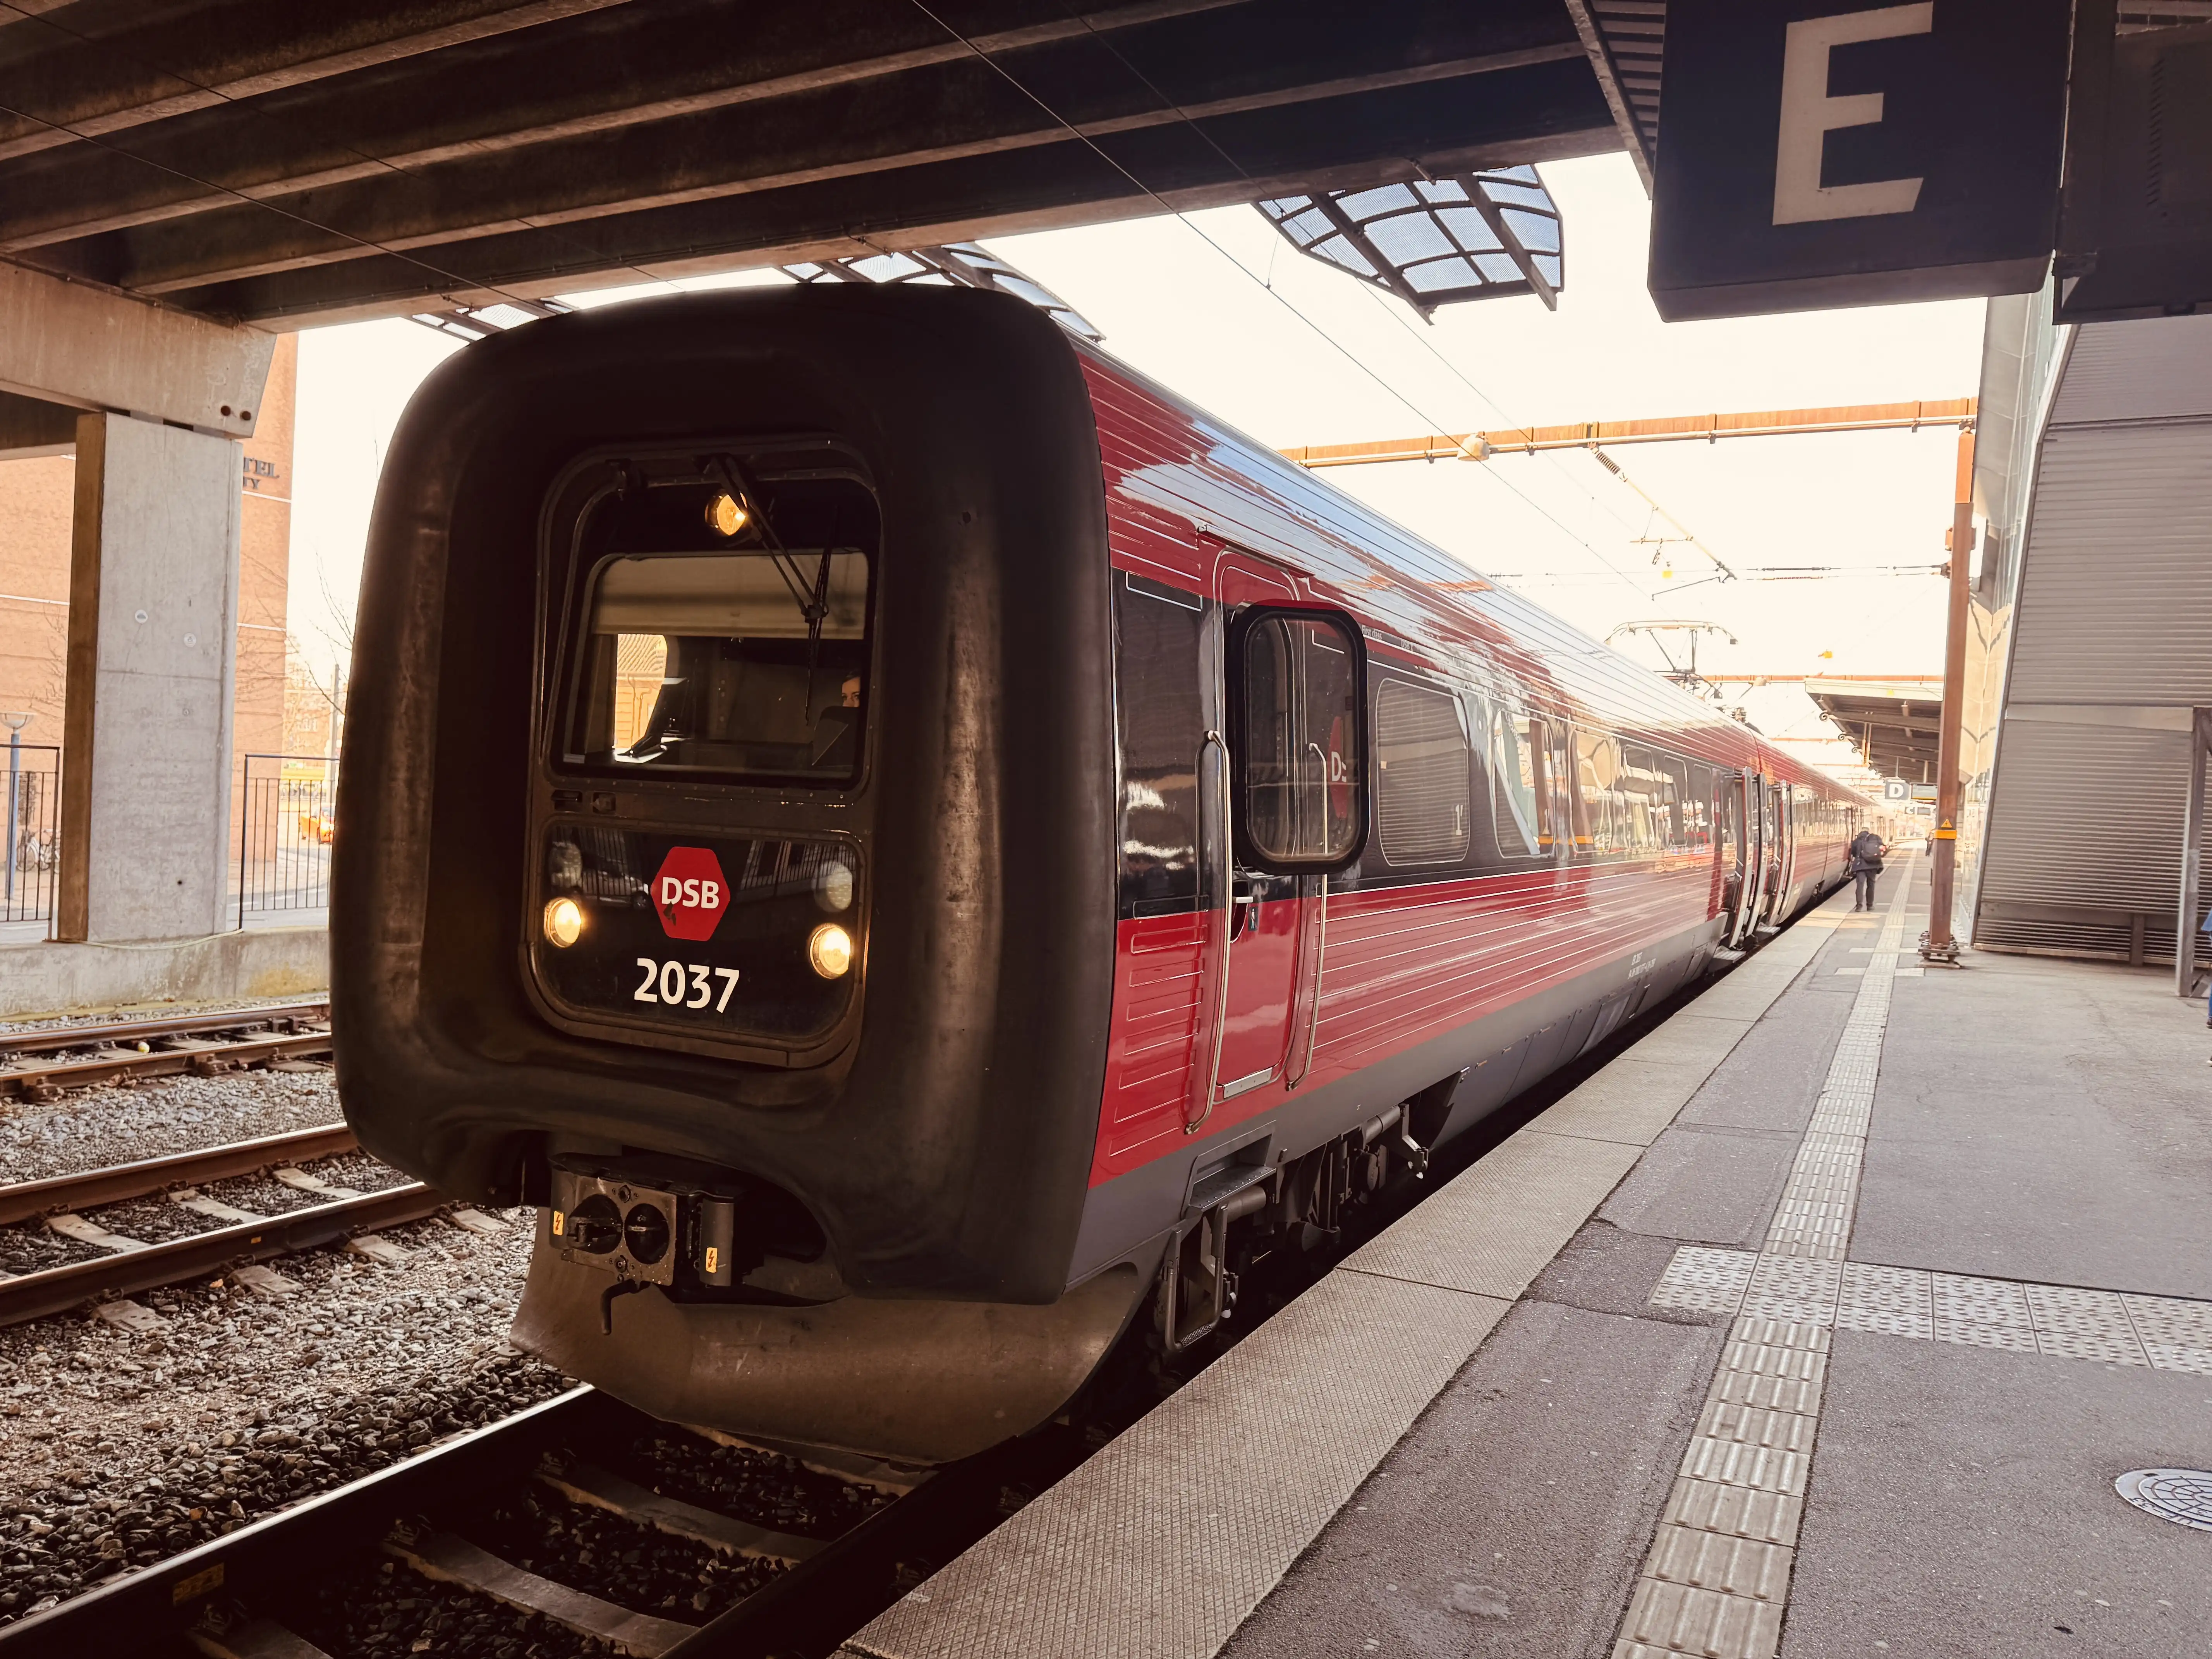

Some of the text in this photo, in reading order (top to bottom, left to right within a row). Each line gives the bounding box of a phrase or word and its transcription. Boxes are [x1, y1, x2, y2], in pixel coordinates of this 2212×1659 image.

[1772, 1, 1933, 226] E
[1362, 624, 1382, 640] First class
[1889, 783, 1904, 798] D
[661, 877, 720, 908] DSB
[634, 958, 739, 1013] 2037
